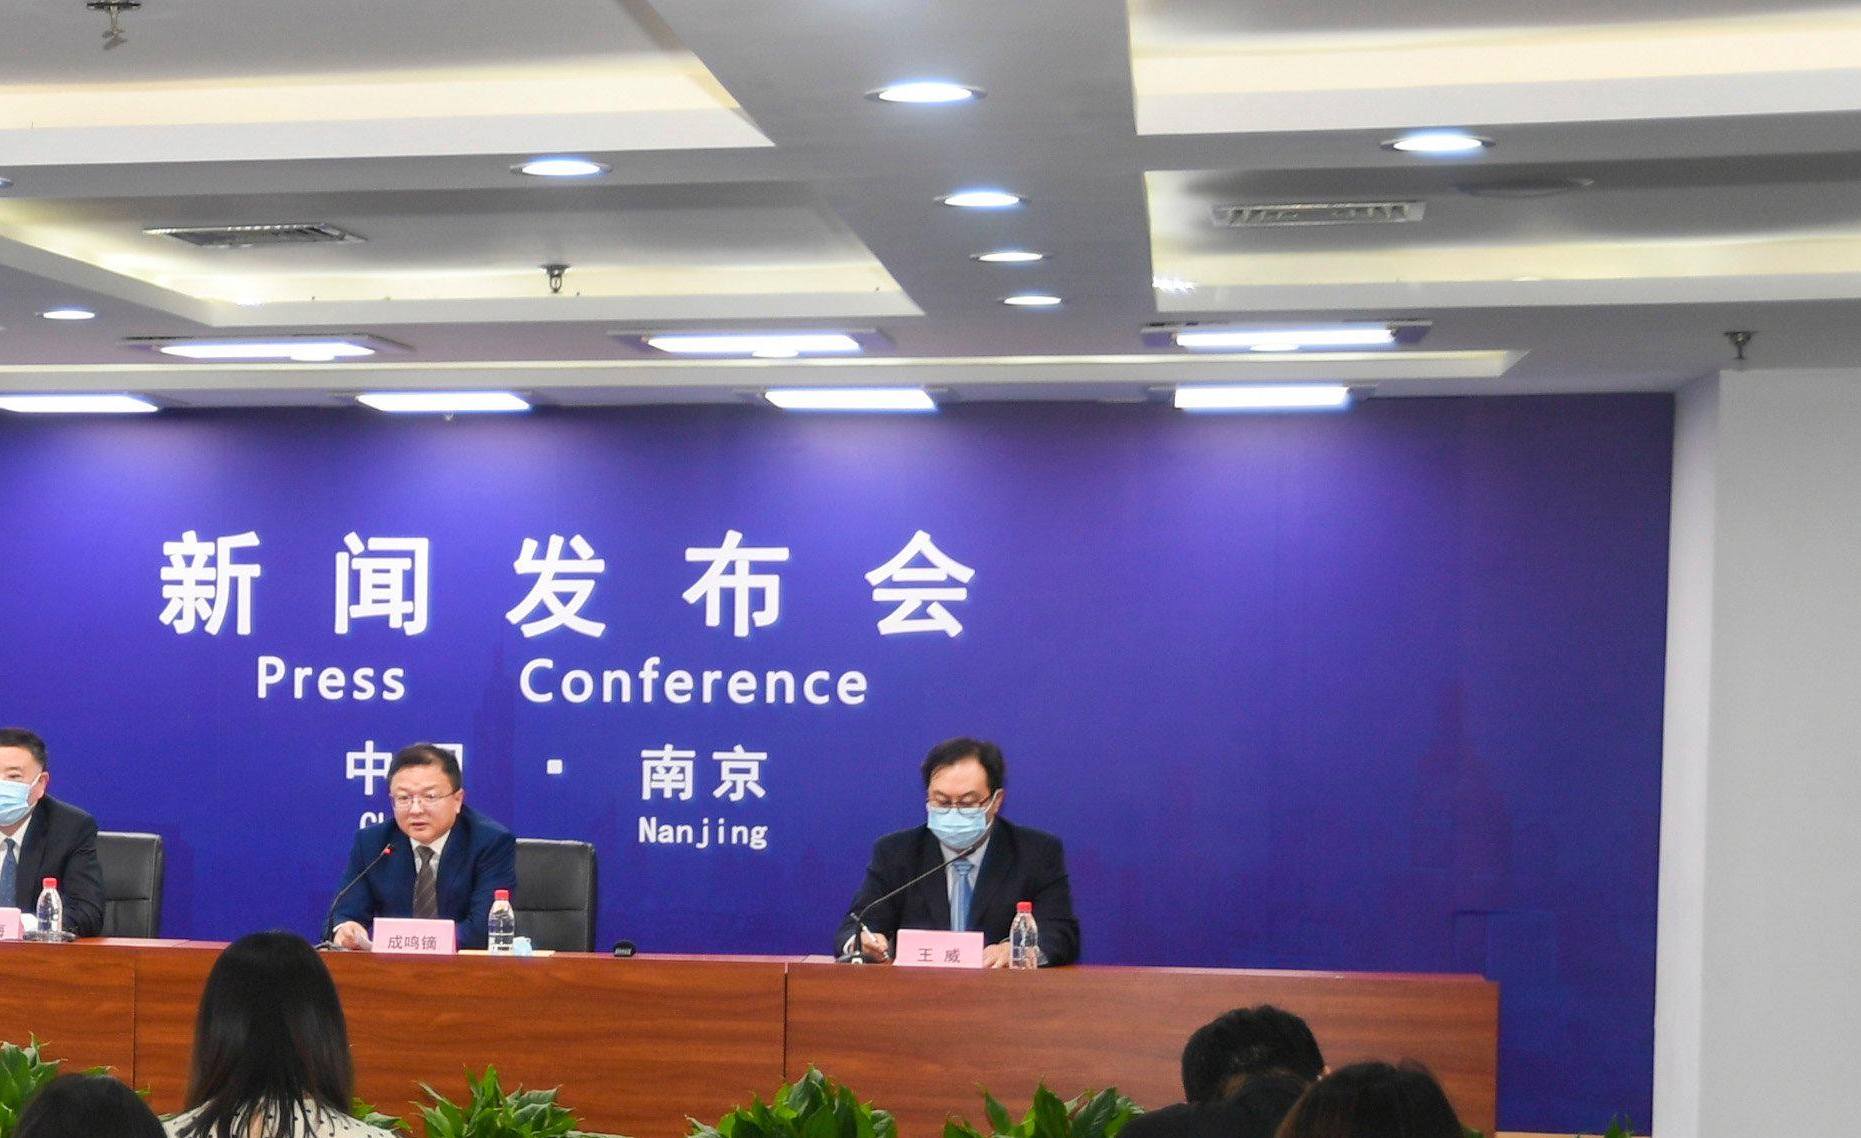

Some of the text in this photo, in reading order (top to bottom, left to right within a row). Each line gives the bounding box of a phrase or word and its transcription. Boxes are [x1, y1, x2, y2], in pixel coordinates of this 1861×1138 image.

[157, 529, 976, 638] 新闻发布会
[256, 656, 869, 705] Press Conference
[637, 816, 768, 851] Nanjing
